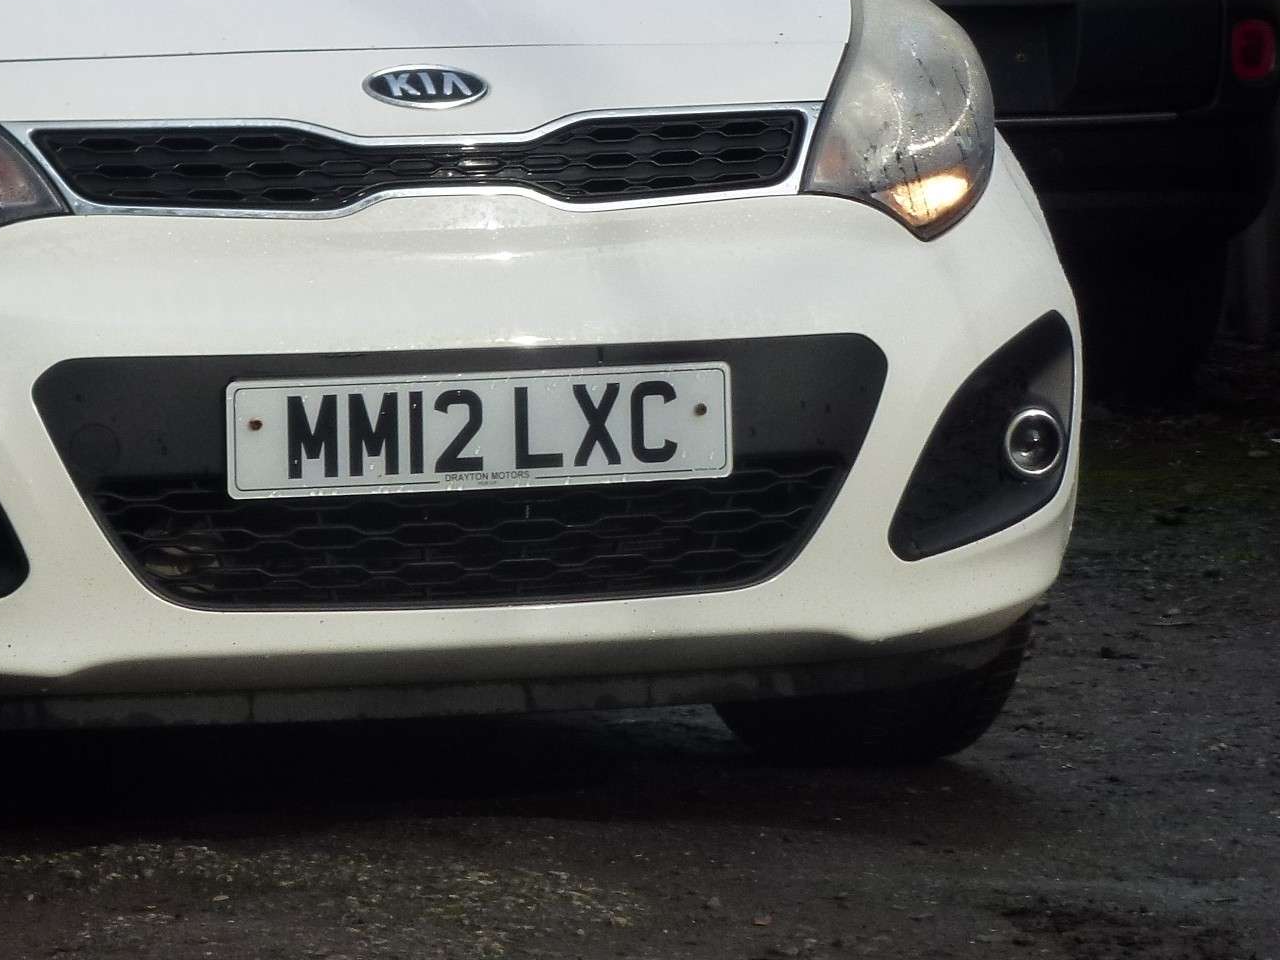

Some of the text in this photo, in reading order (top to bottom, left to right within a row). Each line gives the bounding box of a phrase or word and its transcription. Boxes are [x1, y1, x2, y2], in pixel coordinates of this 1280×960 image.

[383, 71, 473, 96] KIA
[287, 380, 678, 480] MM12 LXC
[444, 470, 530, 482] DRAYTON MOTORS
